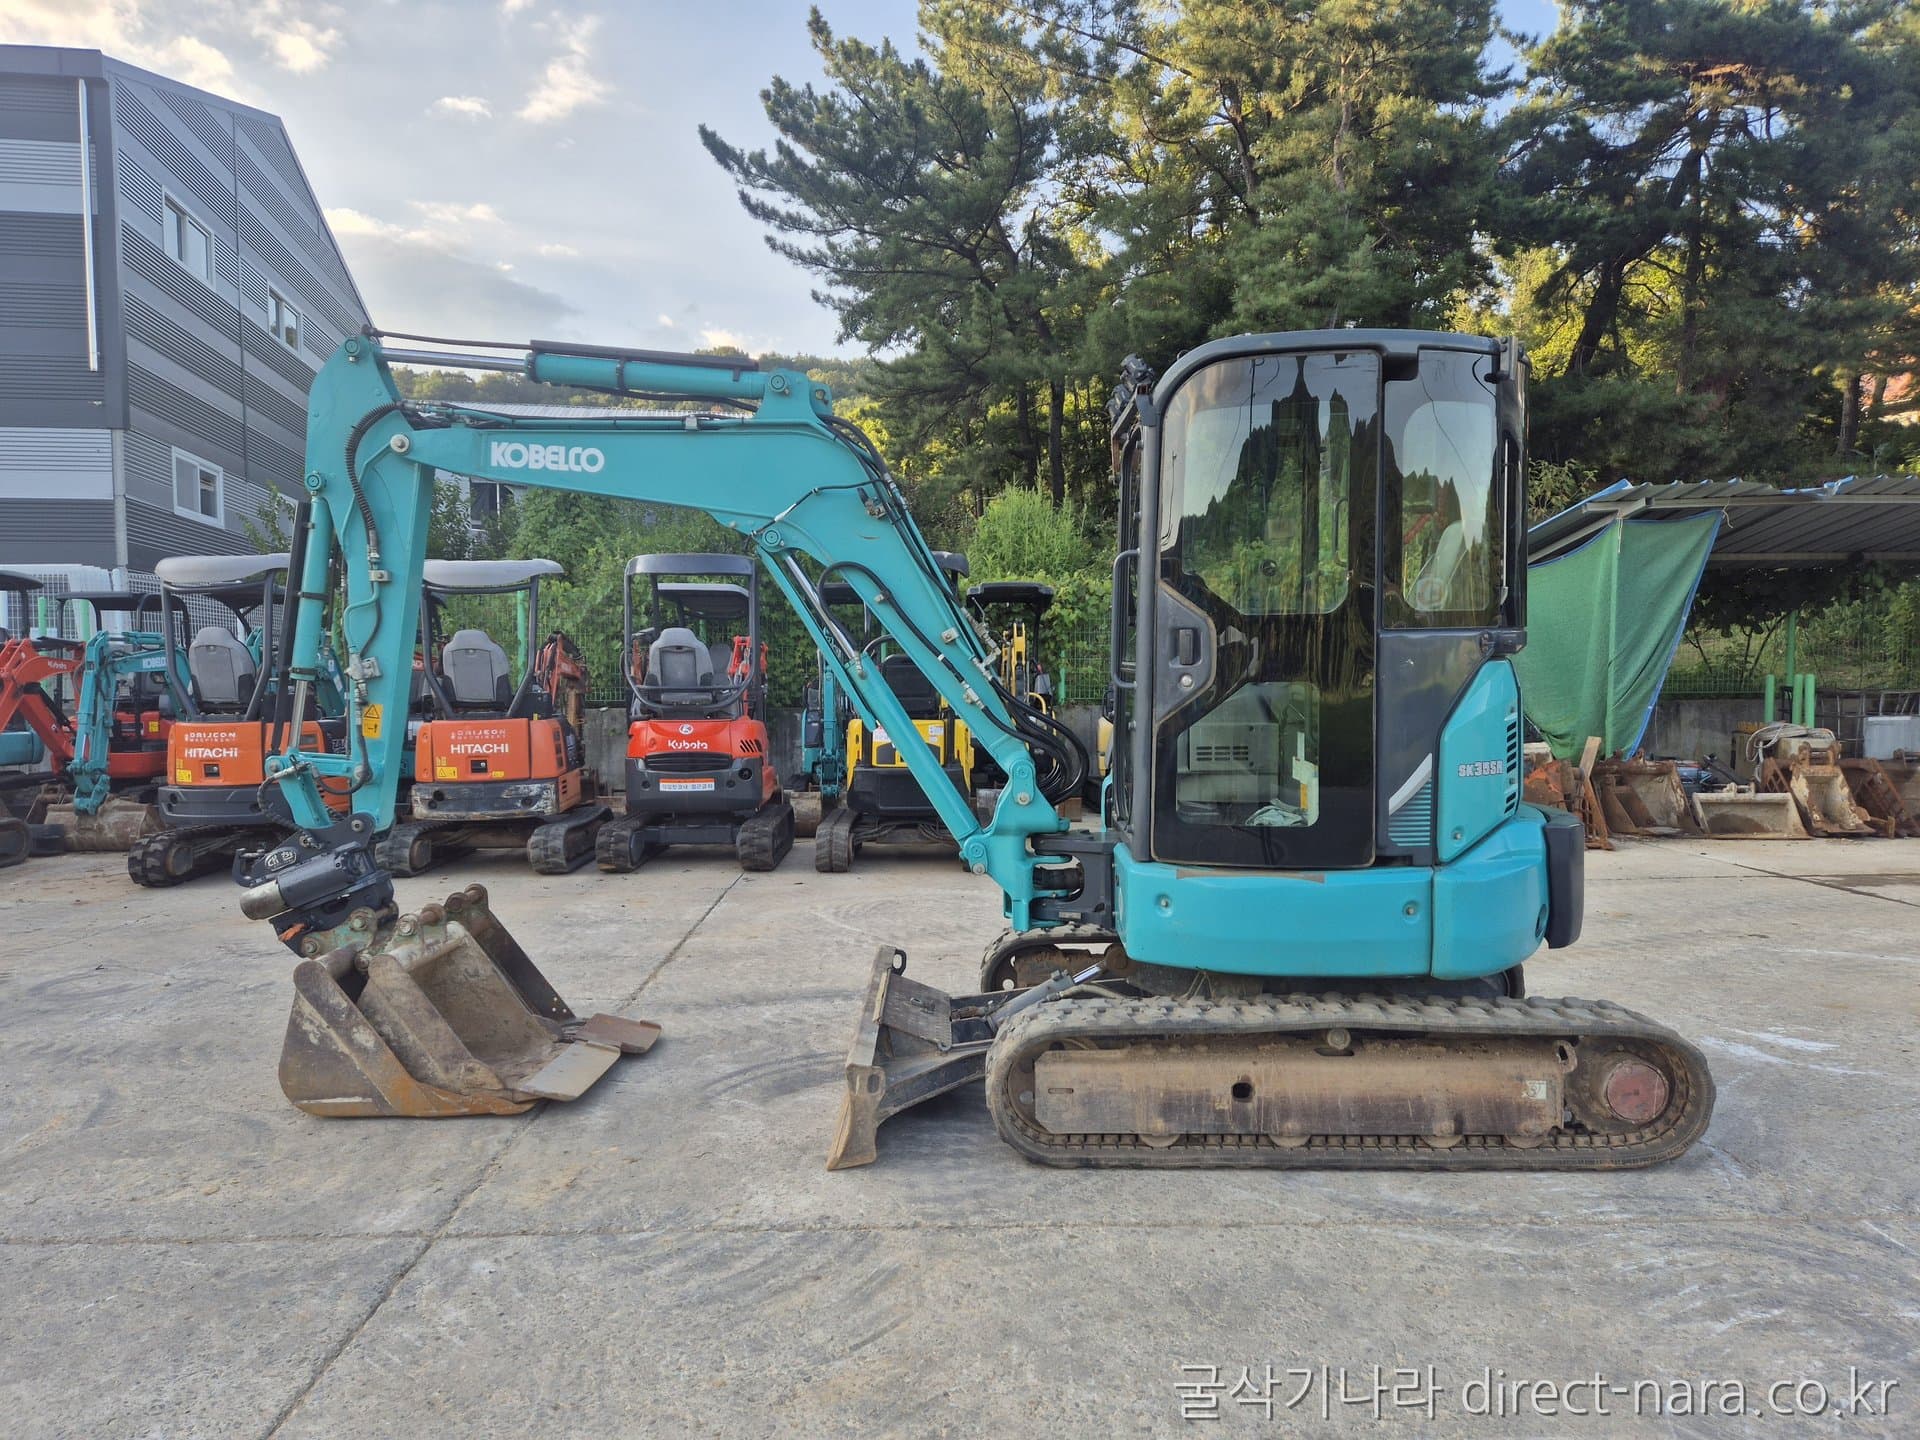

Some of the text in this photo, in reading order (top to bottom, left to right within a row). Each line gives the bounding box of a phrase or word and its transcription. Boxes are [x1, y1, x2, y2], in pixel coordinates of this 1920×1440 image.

[490, 441, 605, 473] KOBELCO
[450, 743, 509, 755] HITACHI
[667, 739, 708, 750] Kubota
[184, 747, 238, 758] HITACHI
